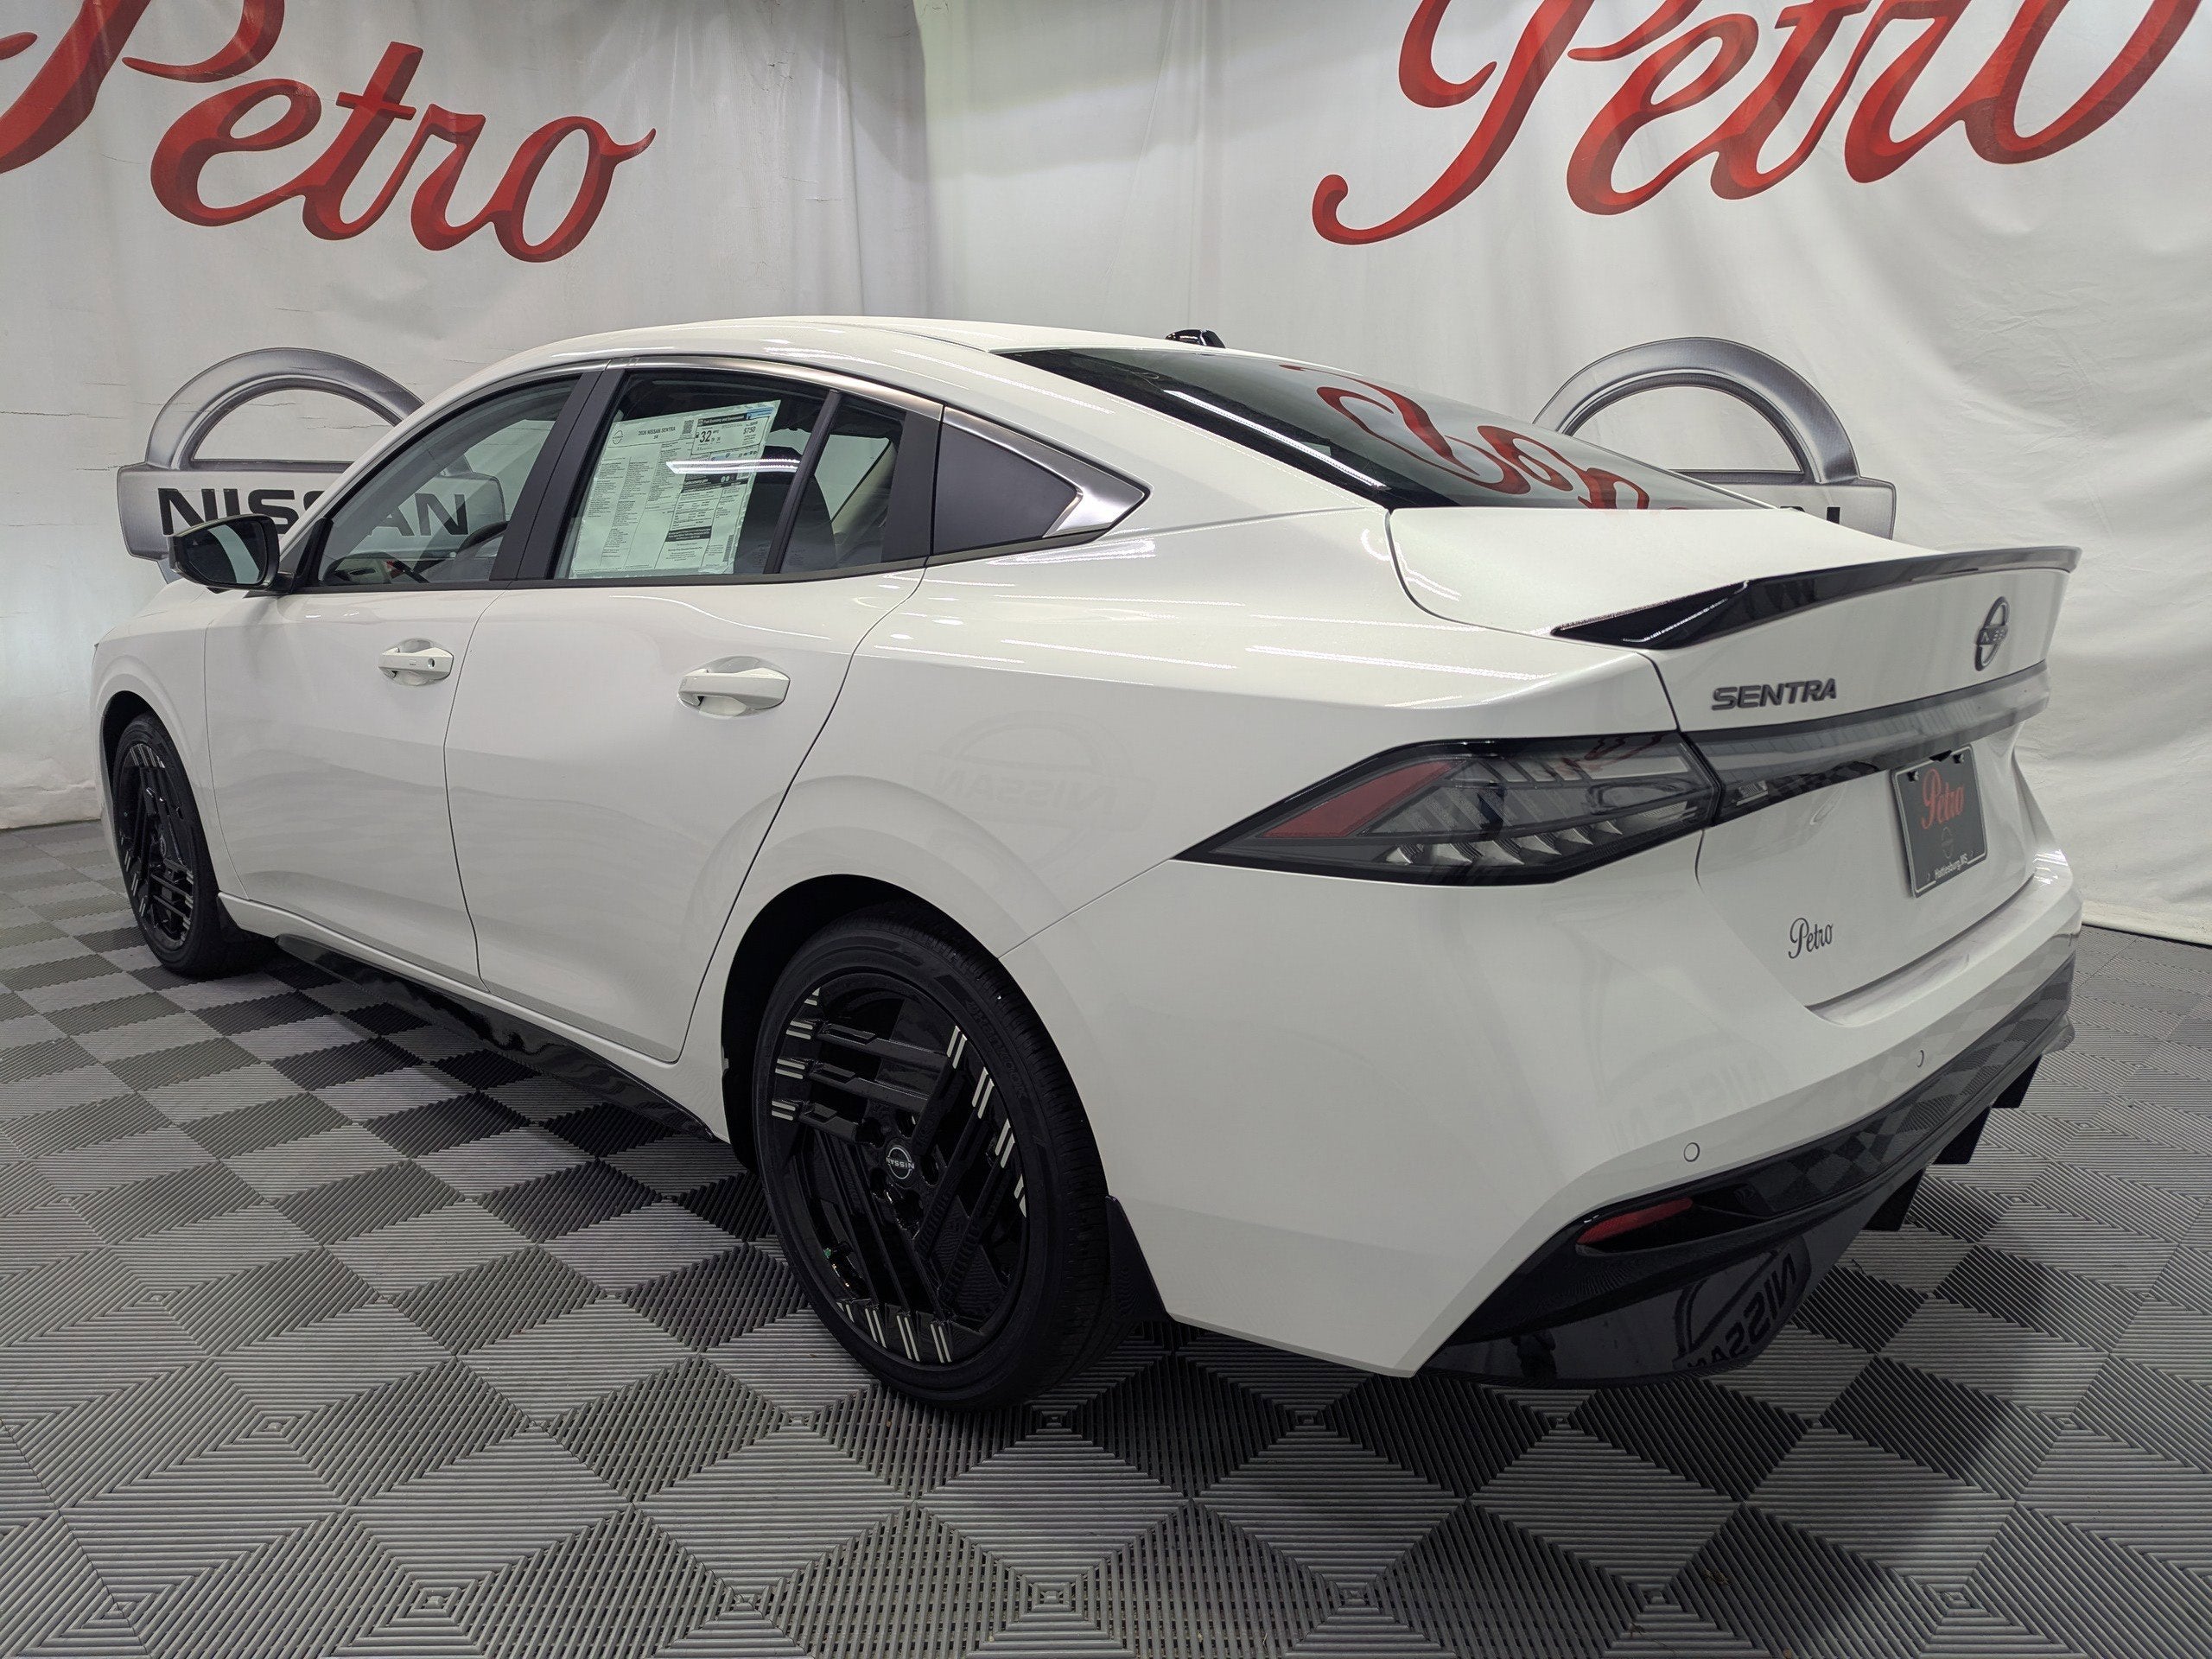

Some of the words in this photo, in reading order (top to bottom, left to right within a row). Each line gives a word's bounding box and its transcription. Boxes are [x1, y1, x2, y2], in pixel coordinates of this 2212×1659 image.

[699, 430, 712, 443] 32
[1711, 677, 1837, 711] SENTRA
[1921, 768, 1965, 830] Petro
[1788, 917, 1834, 959] Petro
